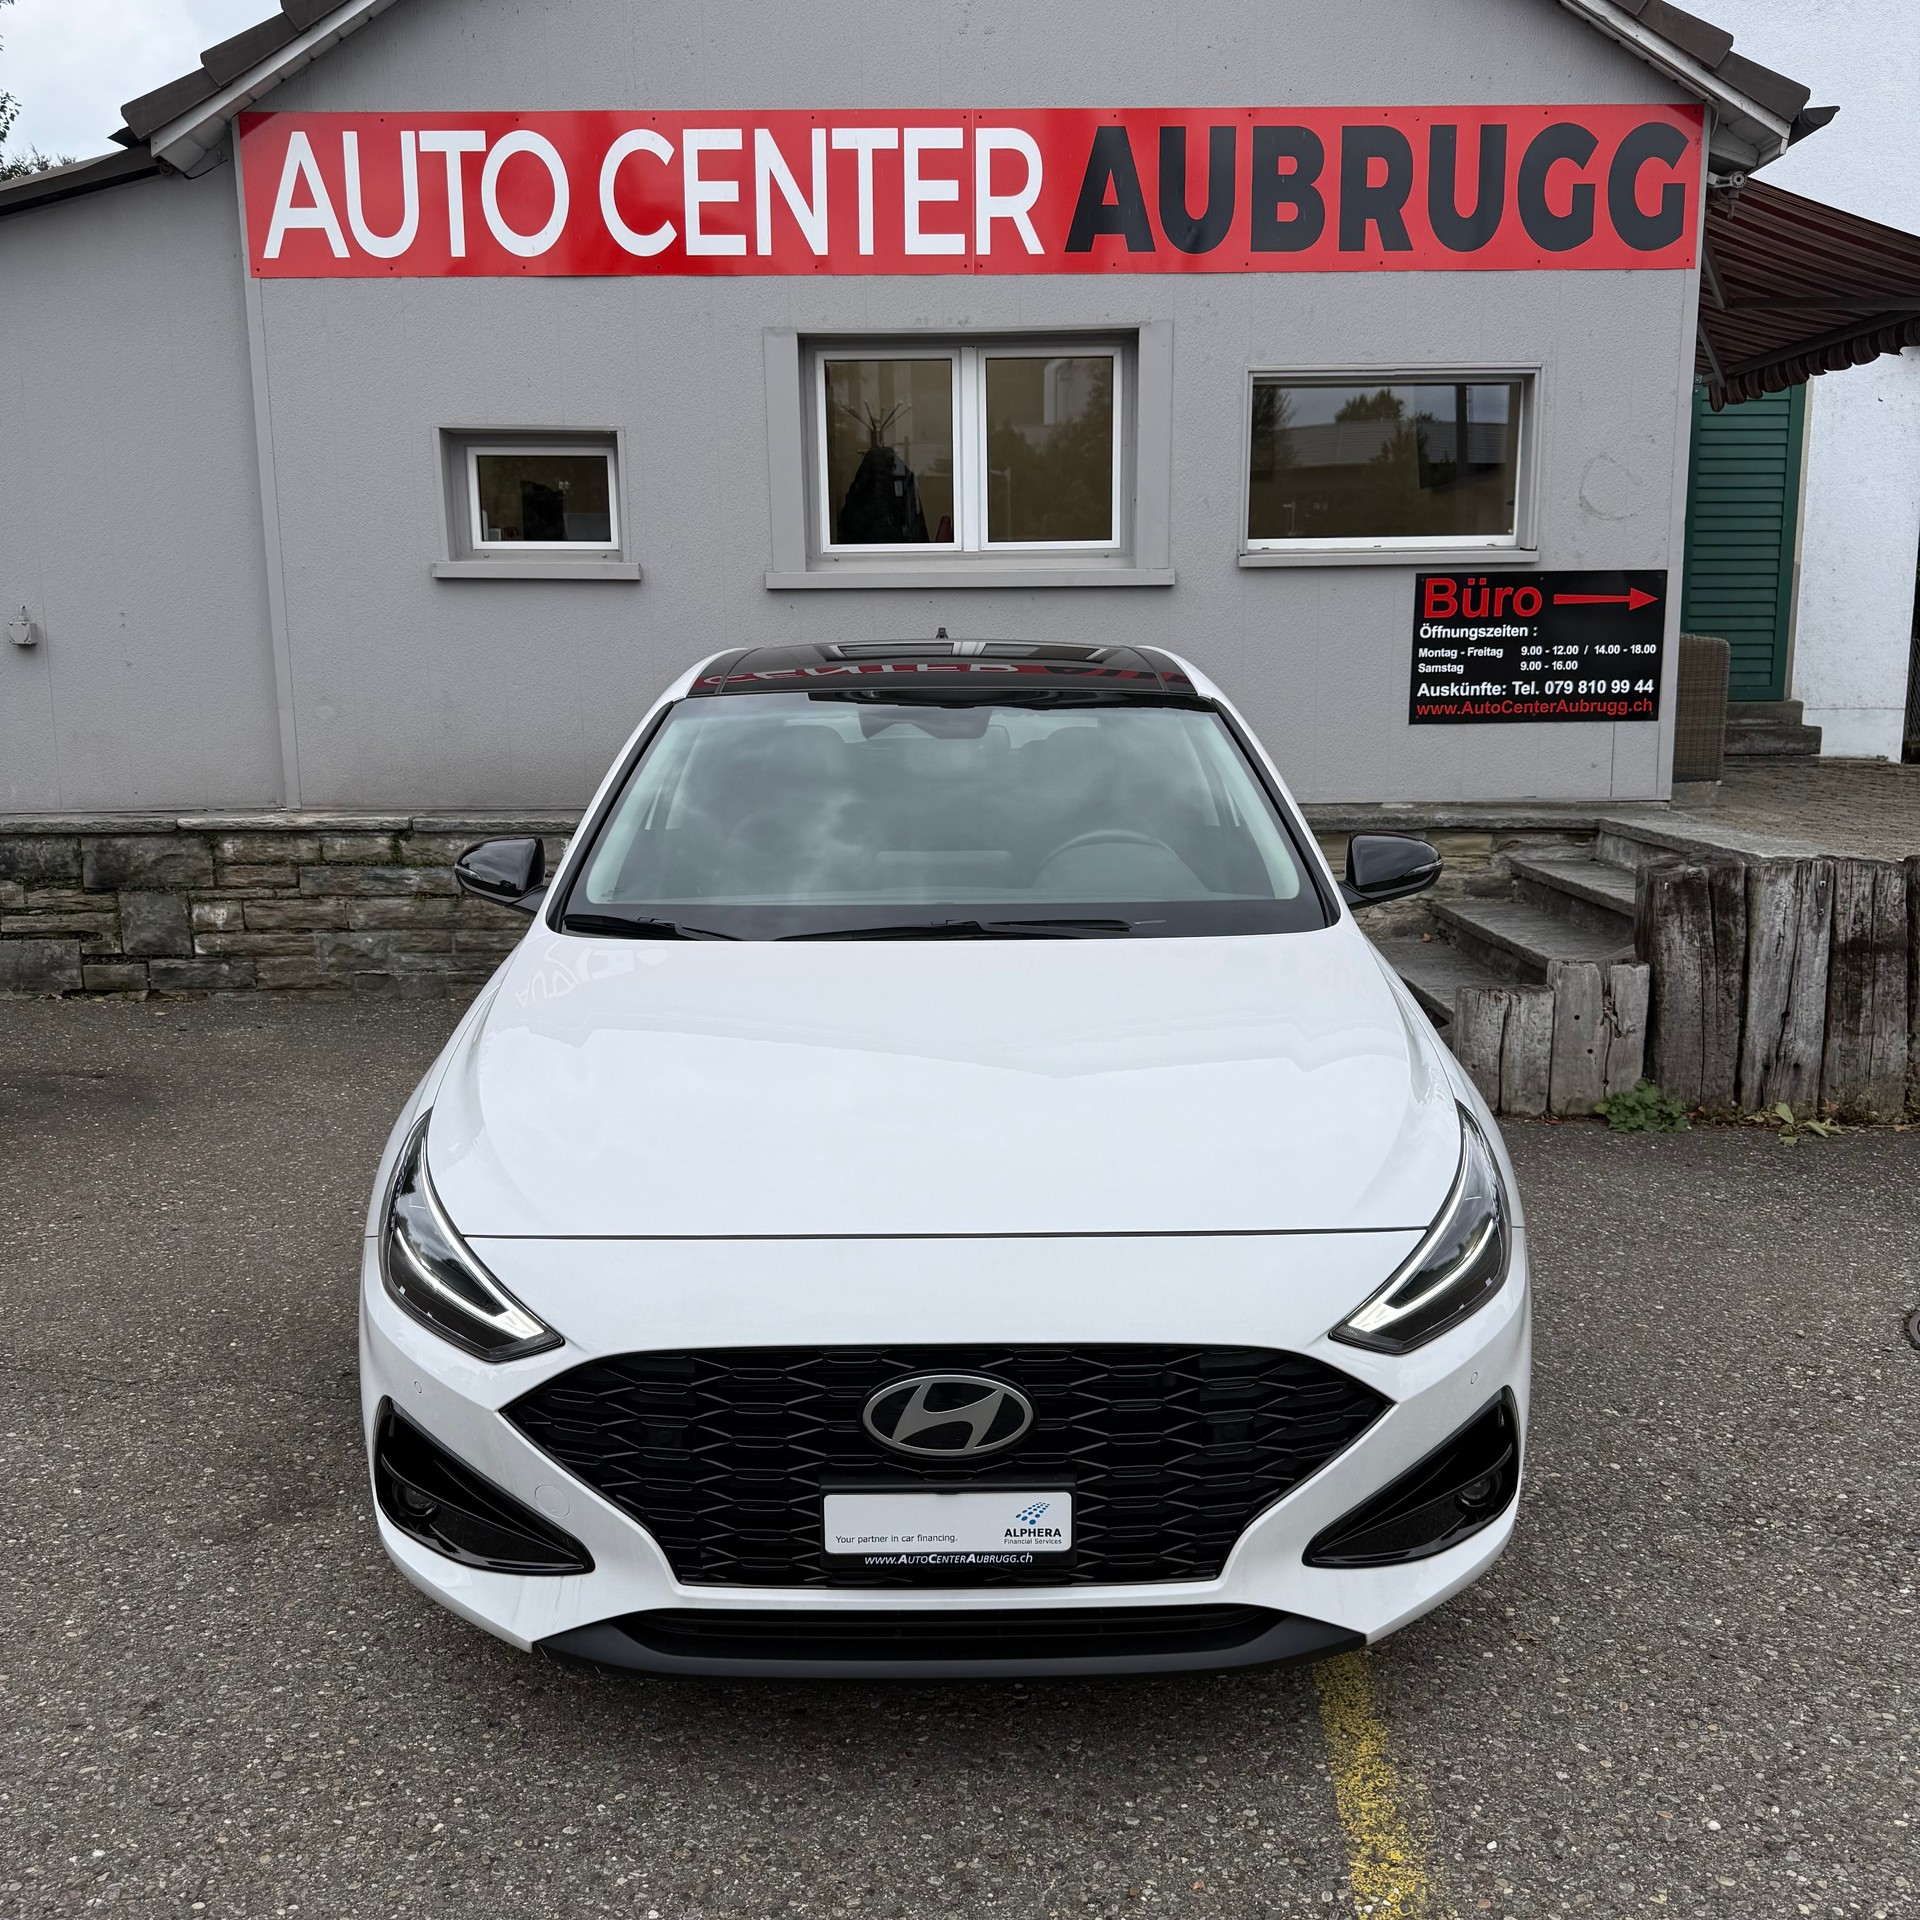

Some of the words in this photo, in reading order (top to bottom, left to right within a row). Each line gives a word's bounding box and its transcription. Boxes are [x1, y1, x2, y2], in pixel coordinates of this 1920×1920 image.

[262, 130, 570, 259] AUTO
[599, 126, 1045, 257] CENTER
[1063, 121, 1690, 254] AUBRUGG
[1424, 578, 1543, 618] Büro
[1420, 624, 1528, 640] Öffnungszeiten
[1418, 648, 1457, 659] Montag
[1467, 647, 1503, 658] Freitag
[1521, 646, 1543, 655] 9.00
[1552, 645, 1579, 655] 12.00
[1594, 645, 1620, 654] 14.00
[1630, 644, 1656, 654] 18.00
[1418, 663, 1464, 674] Samstag
[1520, 661, 1542, 671] 9.00
[1552, 661, 1578, 670] 16.00
[1417, 682, 1506, 697] Auskünfte:
[1512, 681, 1540, 695] Tel.
[1544, 680, 1573, 694] 079
[1578, 680, 1606, 694] 810
[1611, 680, 1630, 693] 99
[1634, 679, 1654, 693] 44
[1417, 698, 1652, 716] www.AutoCenterAubrugg.ch
[836, 1535, 855, 1543] Your
[858, 1535, 888, 1544] partner
[917, 1534, 957, 1543] financing.
[1004, 1528, 1062, 1537] ALPHERA
